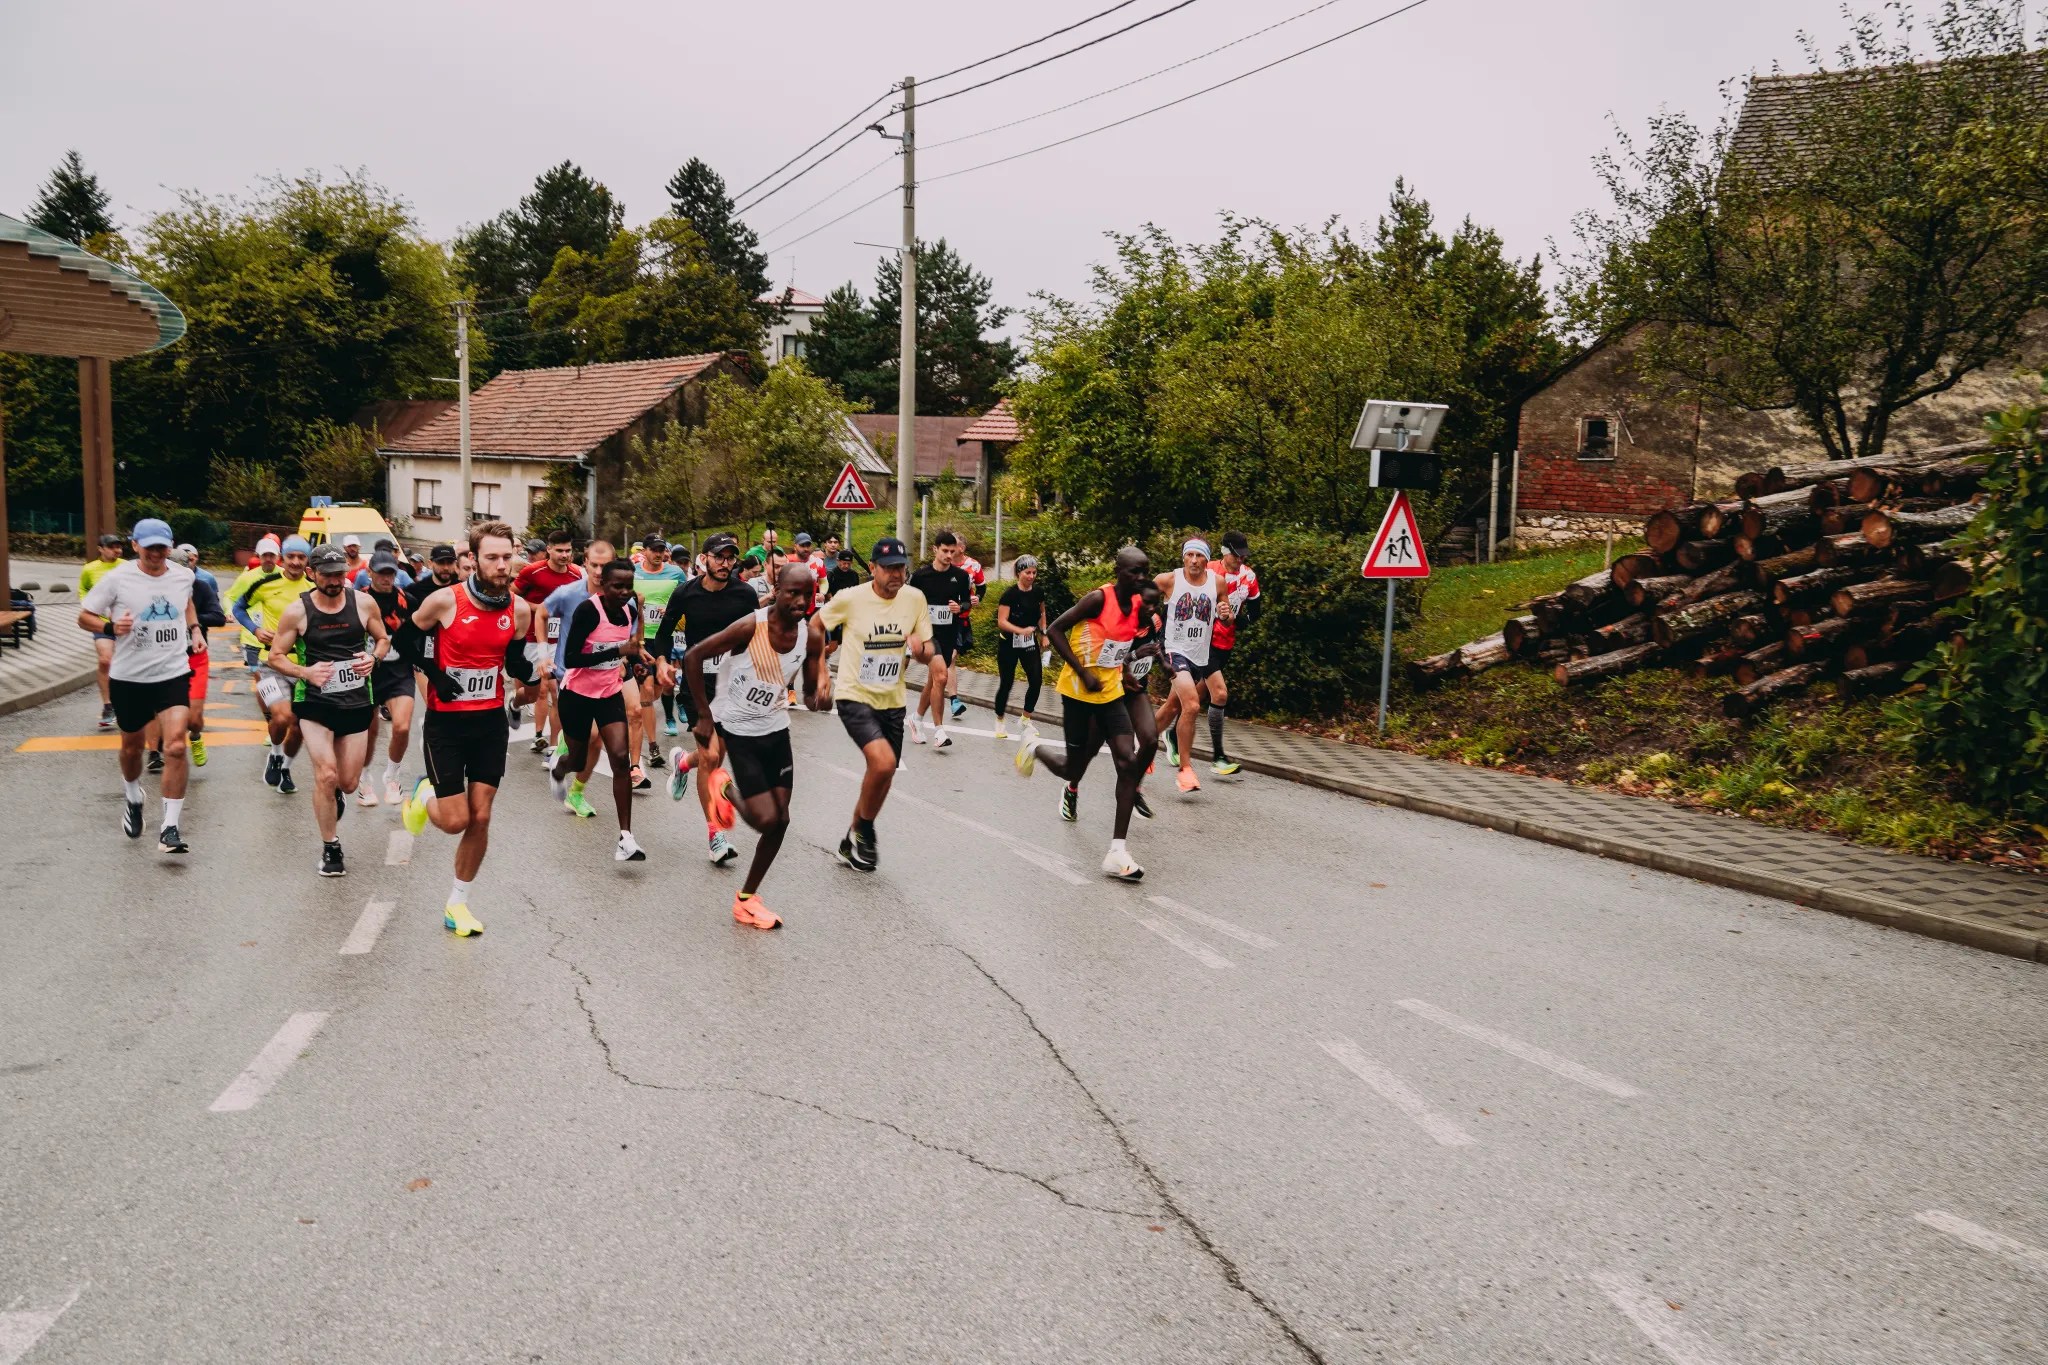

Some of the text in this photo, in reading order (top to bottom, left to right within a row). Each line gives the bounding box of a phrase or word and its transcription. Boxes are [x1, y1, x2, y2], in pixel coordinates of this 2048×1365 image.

[938, 610, 951, 619] 007
[548, 622, 560, 632] 07
[888, 623, 899, 631] 17
[1187, 627, 1203, 638] 081
[878, 663, 899, 677] 070
[468, 675, 494, 692] 010
[746, 687, 774, 707] 029
